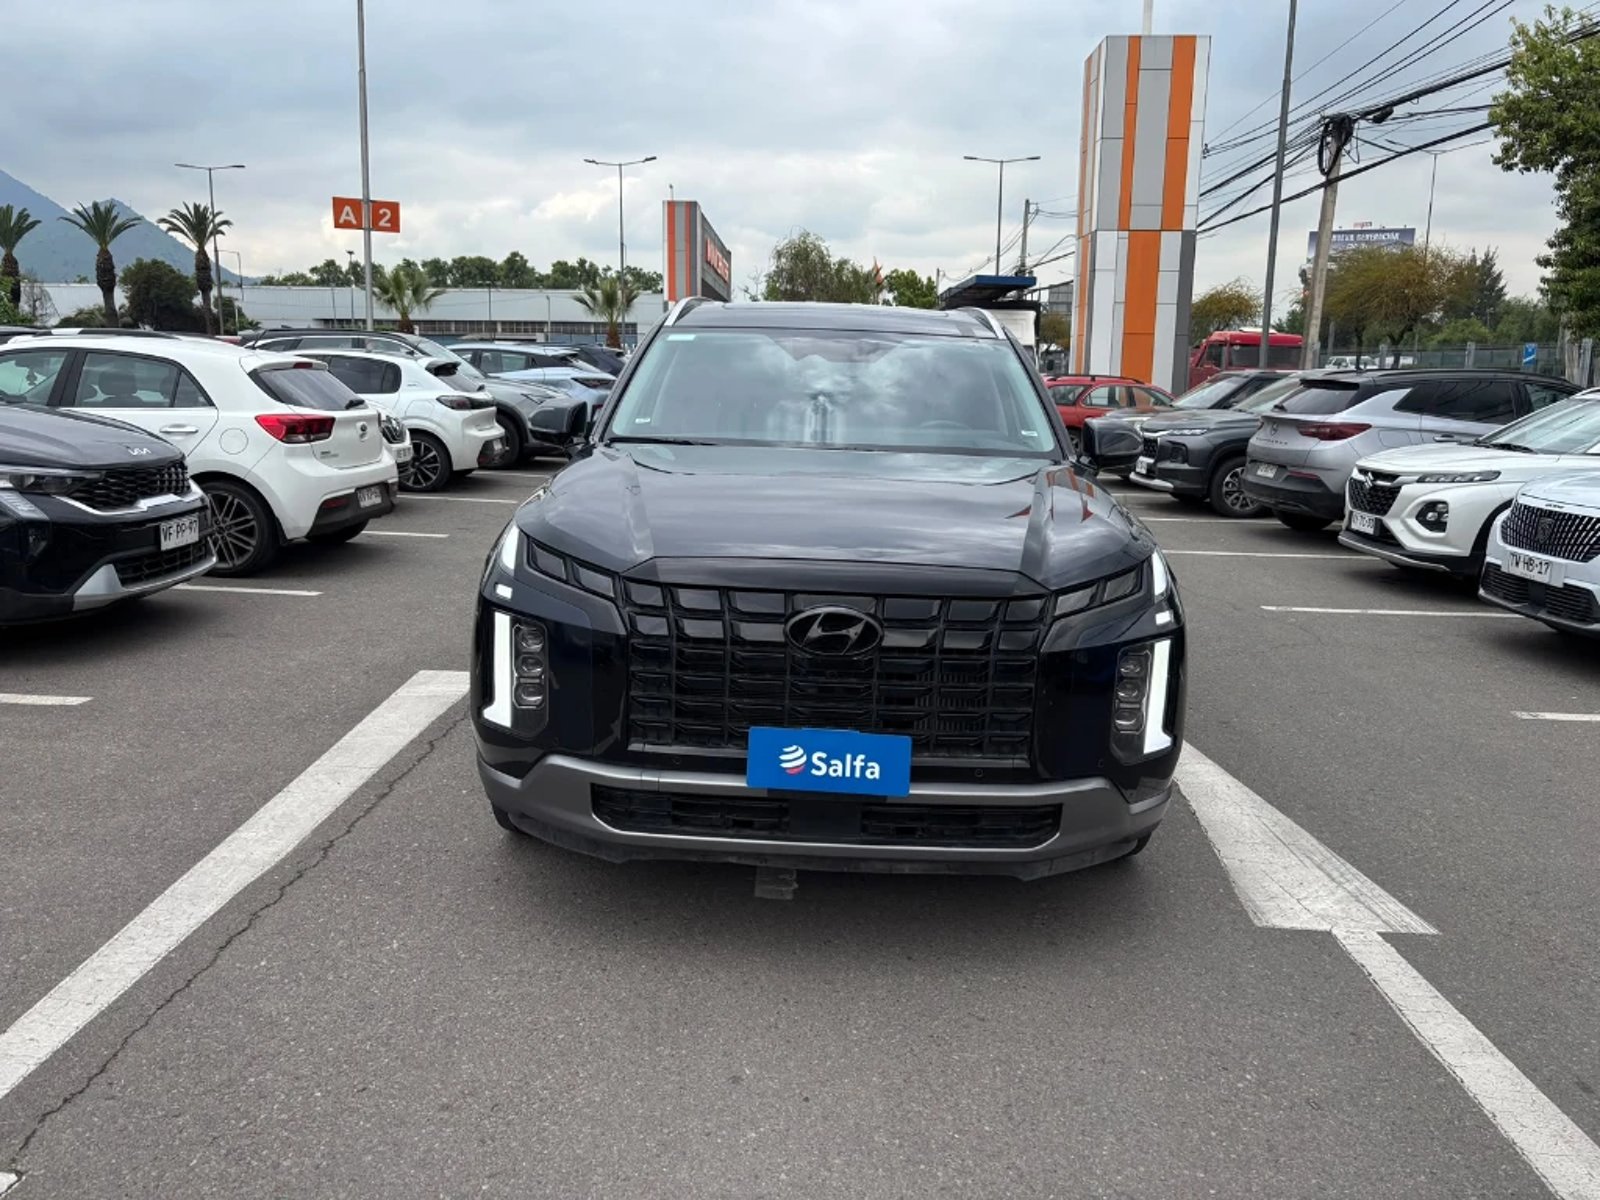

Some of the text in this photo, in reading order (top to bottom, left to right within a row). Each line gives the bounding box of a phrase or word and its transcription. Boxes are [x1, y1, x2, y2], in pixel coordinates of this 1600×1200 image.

[339, 205, 392, 227] A 2
[810, 751, 881, 780] Salfa
